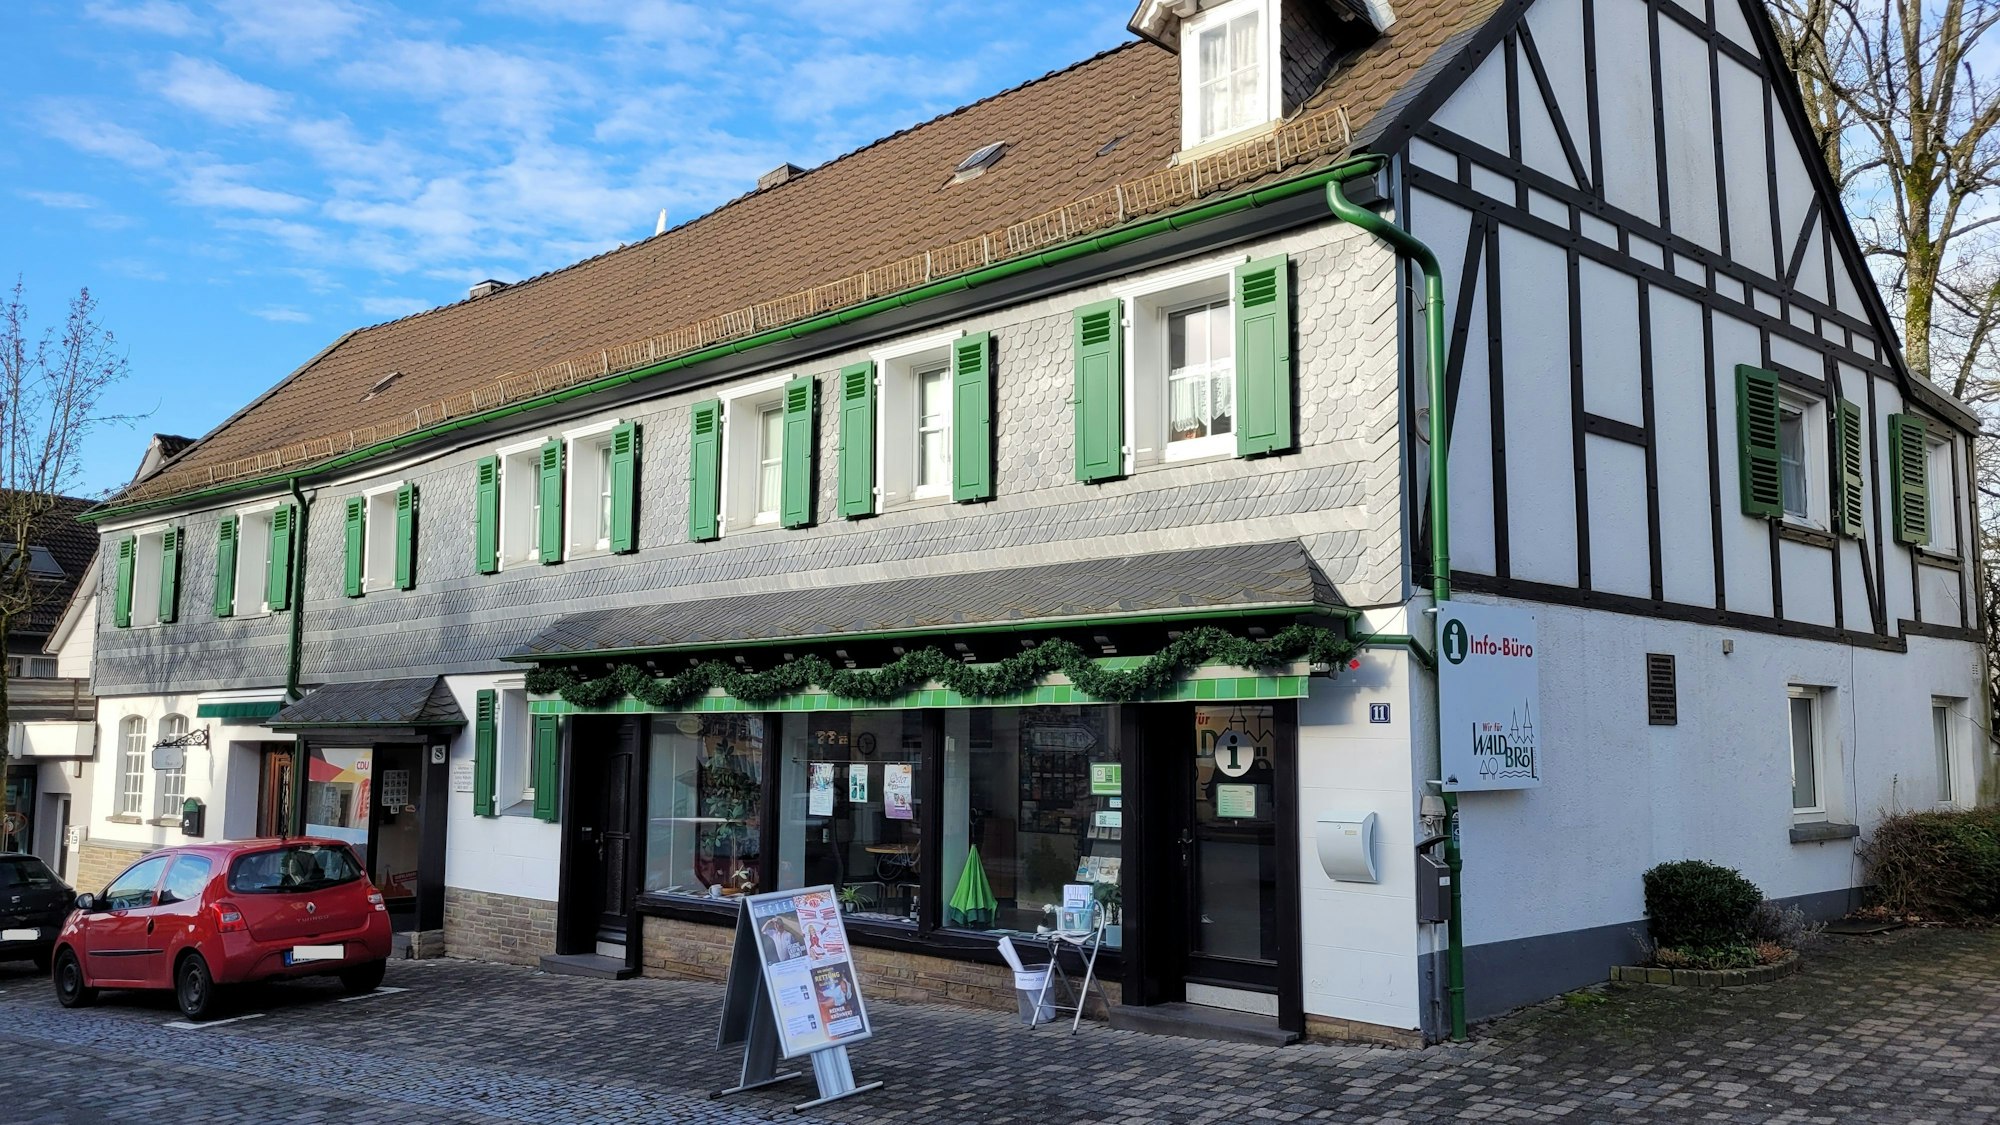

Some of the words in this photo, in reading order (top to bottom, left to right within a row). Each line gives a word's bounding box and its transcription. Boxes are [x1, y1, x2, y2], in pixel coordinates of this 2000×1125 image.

[1471, 634, 1533, 658] Info-Büro
[1373, 705, 1385, 720] 11
[1482, 722, 1493, 732] Wir
[1494, 722, 1503, 732] für
[357, 761, 369, 770] CDU
[296, 914, 329, 923] TWINGO
